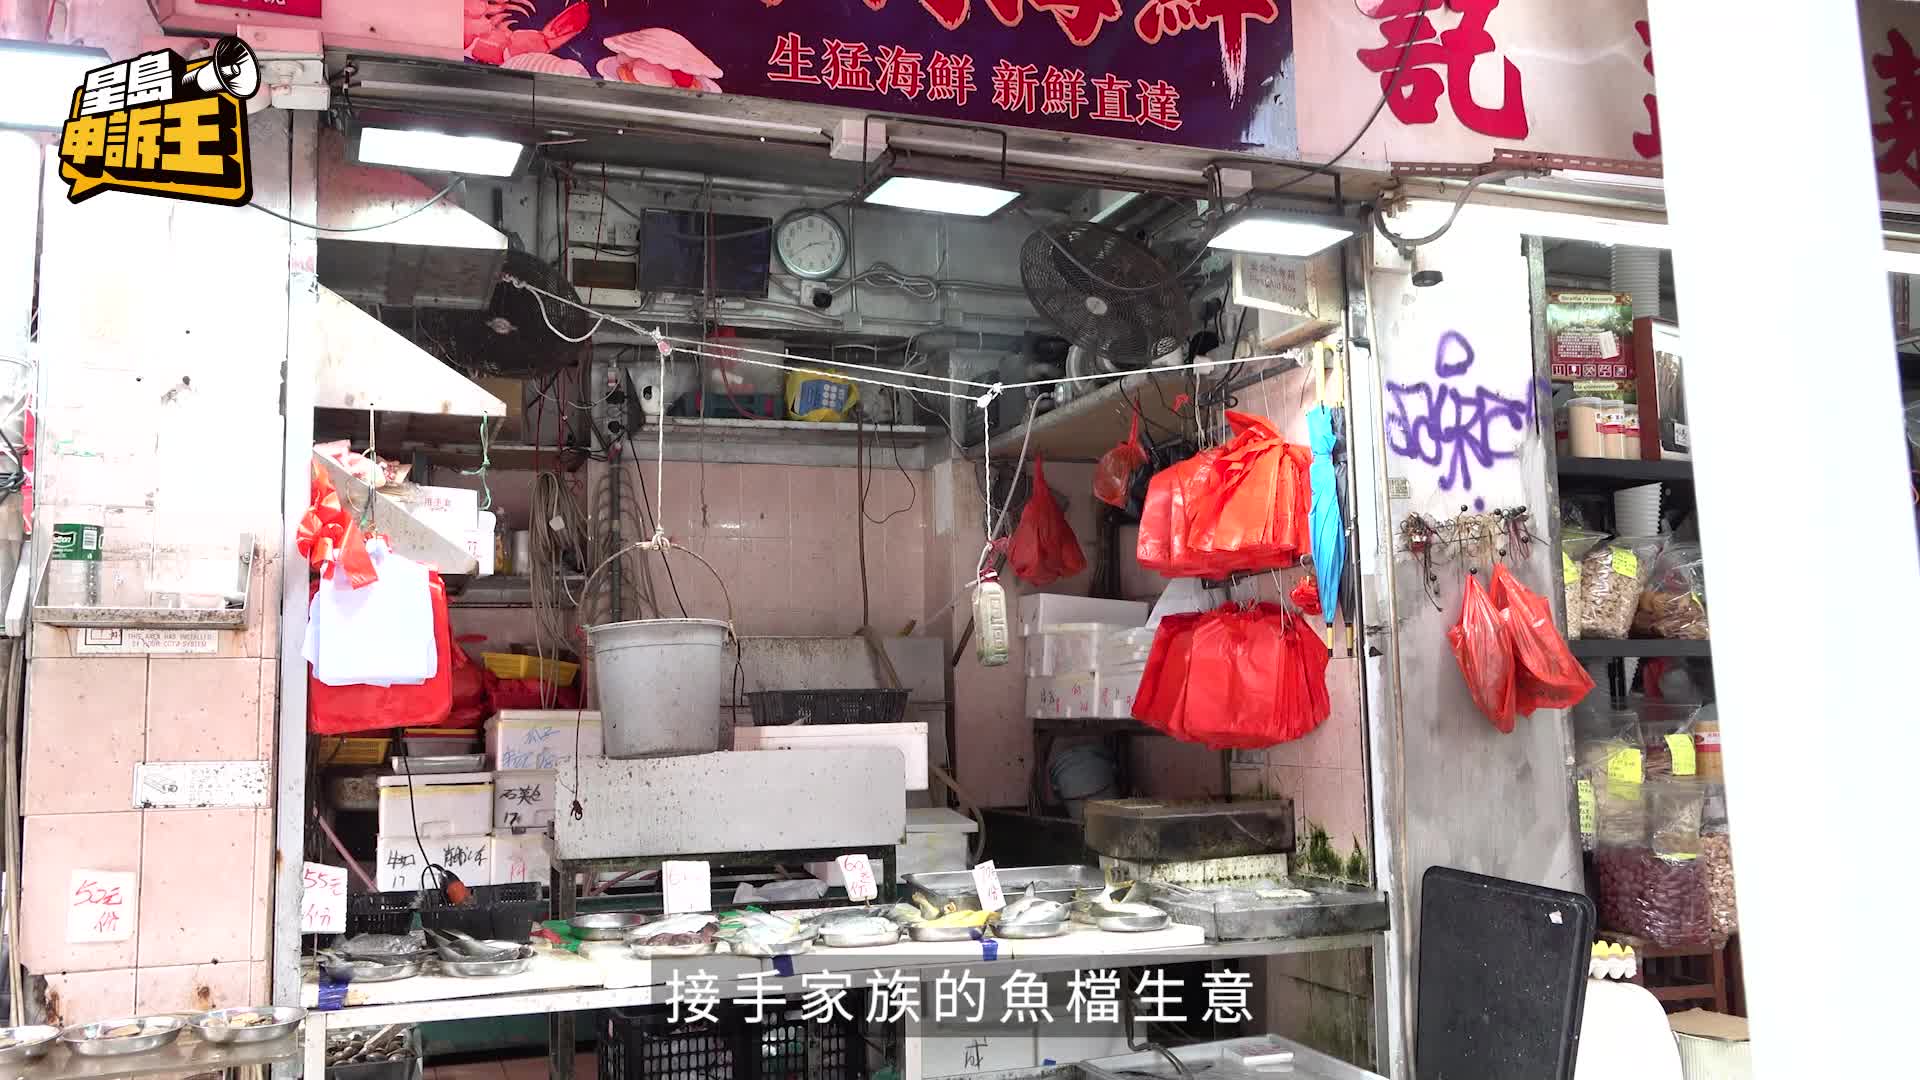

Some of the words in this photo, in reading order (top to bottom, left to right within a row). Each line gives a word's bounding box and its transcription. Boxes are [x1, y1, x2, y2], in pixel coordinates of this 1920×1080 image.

[767, 32, 977, 106] 生猛海鮮
[990, 58, 1183, 132] 新鮮直達
